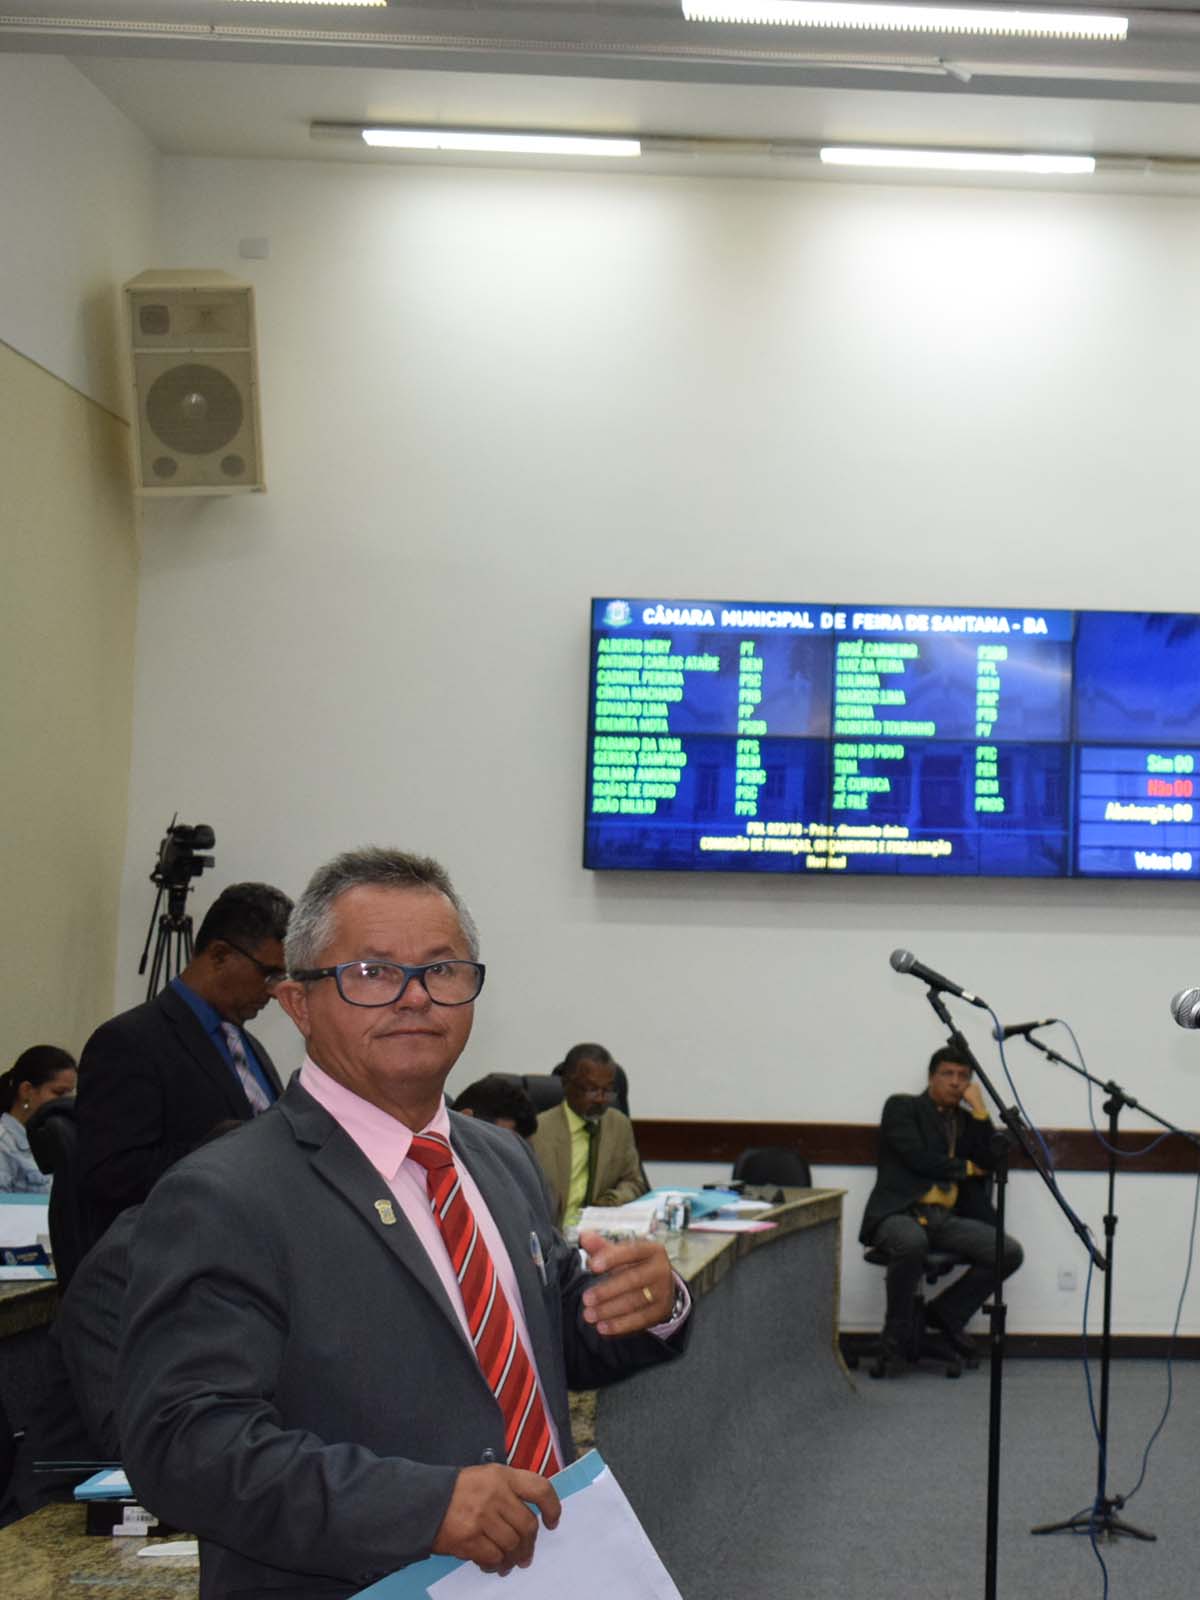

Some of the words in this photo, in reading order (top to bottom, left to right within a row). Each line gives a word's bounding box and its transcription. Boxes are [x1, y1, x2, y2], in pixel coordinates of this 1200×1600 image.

[643, 604, 715, 626] CÂMARA
[721, 609, 814, 629] MUNICIPAL
[820, 612, 846, 629] DE
[853, 613, 903, 631] FEIRA
[906, 614, 929, 632] DE
[931, 615, 1010, 633] SANTANA
[1023, 617, 1048, 634] BA
